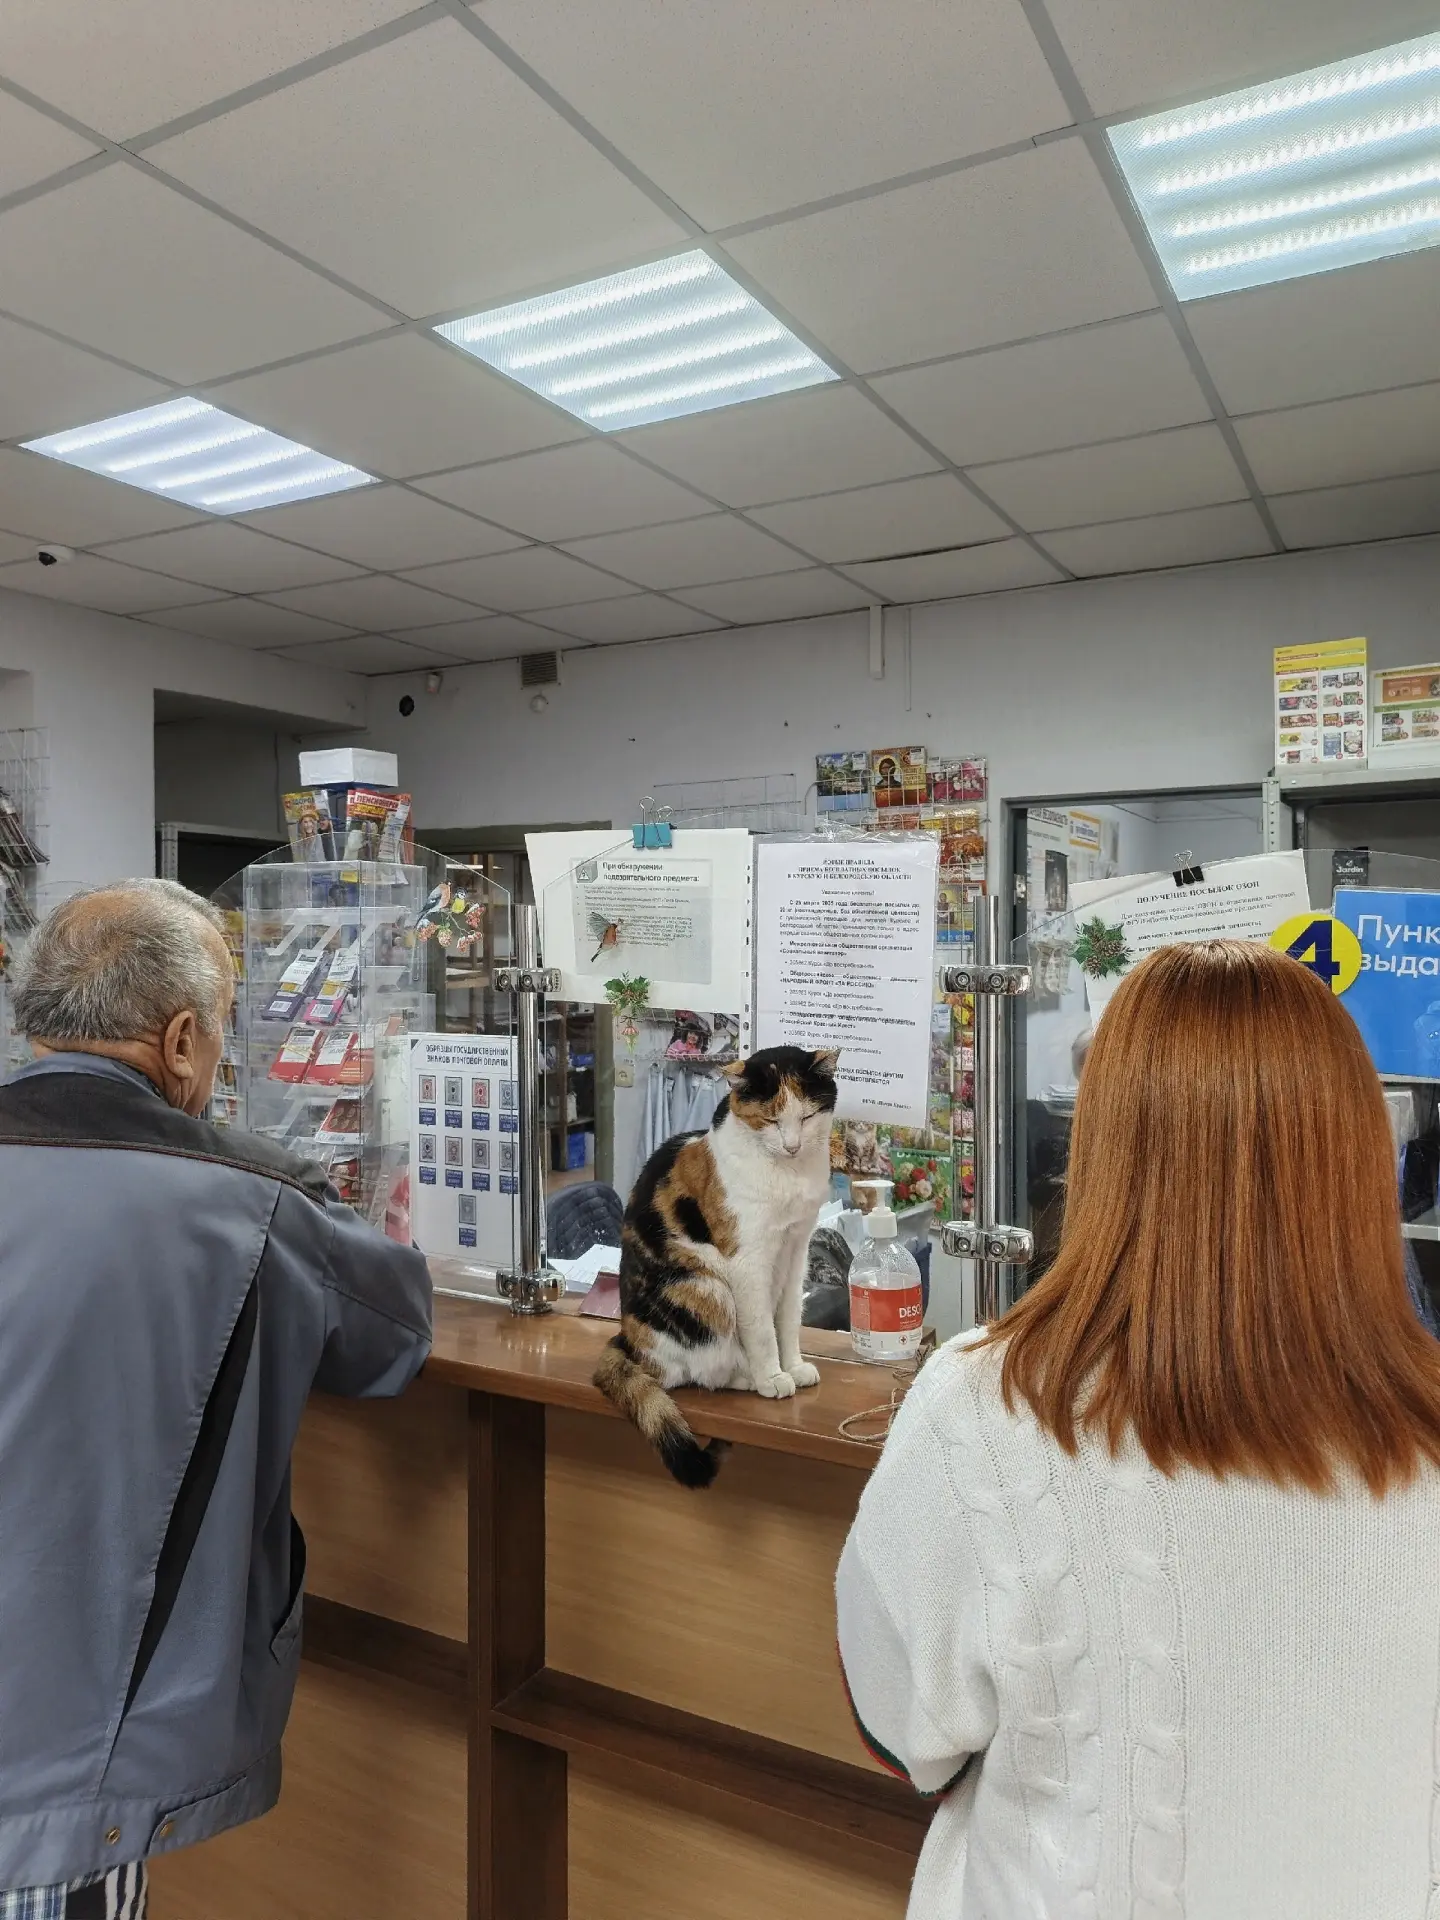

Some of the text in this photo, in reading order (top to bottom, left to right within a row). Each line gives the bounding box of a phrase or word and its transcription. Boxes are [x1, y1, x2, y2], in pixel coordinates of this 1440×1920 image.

[603, 862, 663, 871] При обнаружении
[1336, 866, 1364, 874] Jardin
[1136, 891, 1188, 904] ПОЛУЧЕНИЕ
[1189, 884, 1234, 896] ПОСЫЛОК
[1285, 919, 1341, 991] 4
[426, 1044, 509, 1055] ОБРАЗЦЫ ГОСУДАРСТВЕННЫХ
[426, 1056, 509, 1066] ЗНАКОВ ПОЧТОВОЙ ОПЛАТЫ
